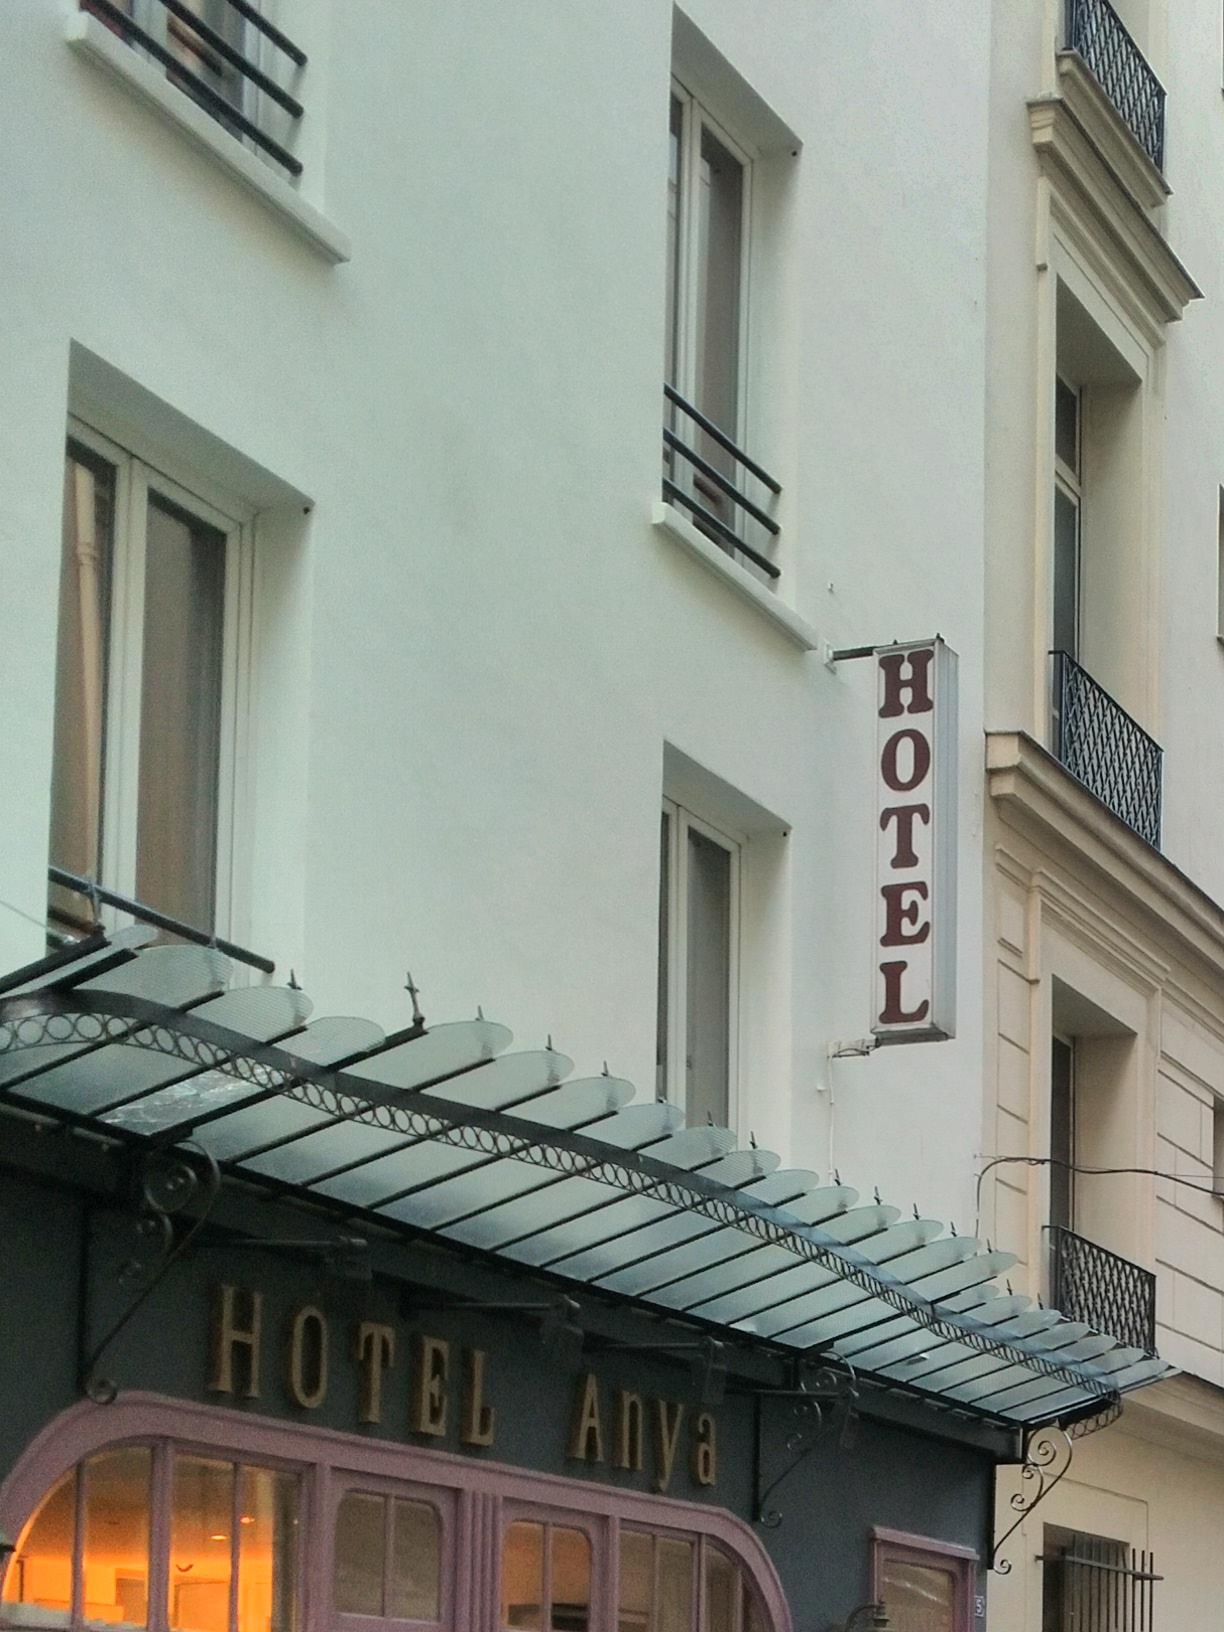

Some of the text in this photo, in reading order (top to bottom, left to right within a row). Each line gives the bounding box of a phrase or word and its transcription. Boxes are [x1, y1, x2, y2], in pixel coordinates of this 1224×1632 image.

[878, 648, 934, 1025] HOTEL
[207, 1283, 717, 1492] HOTEL Anya
